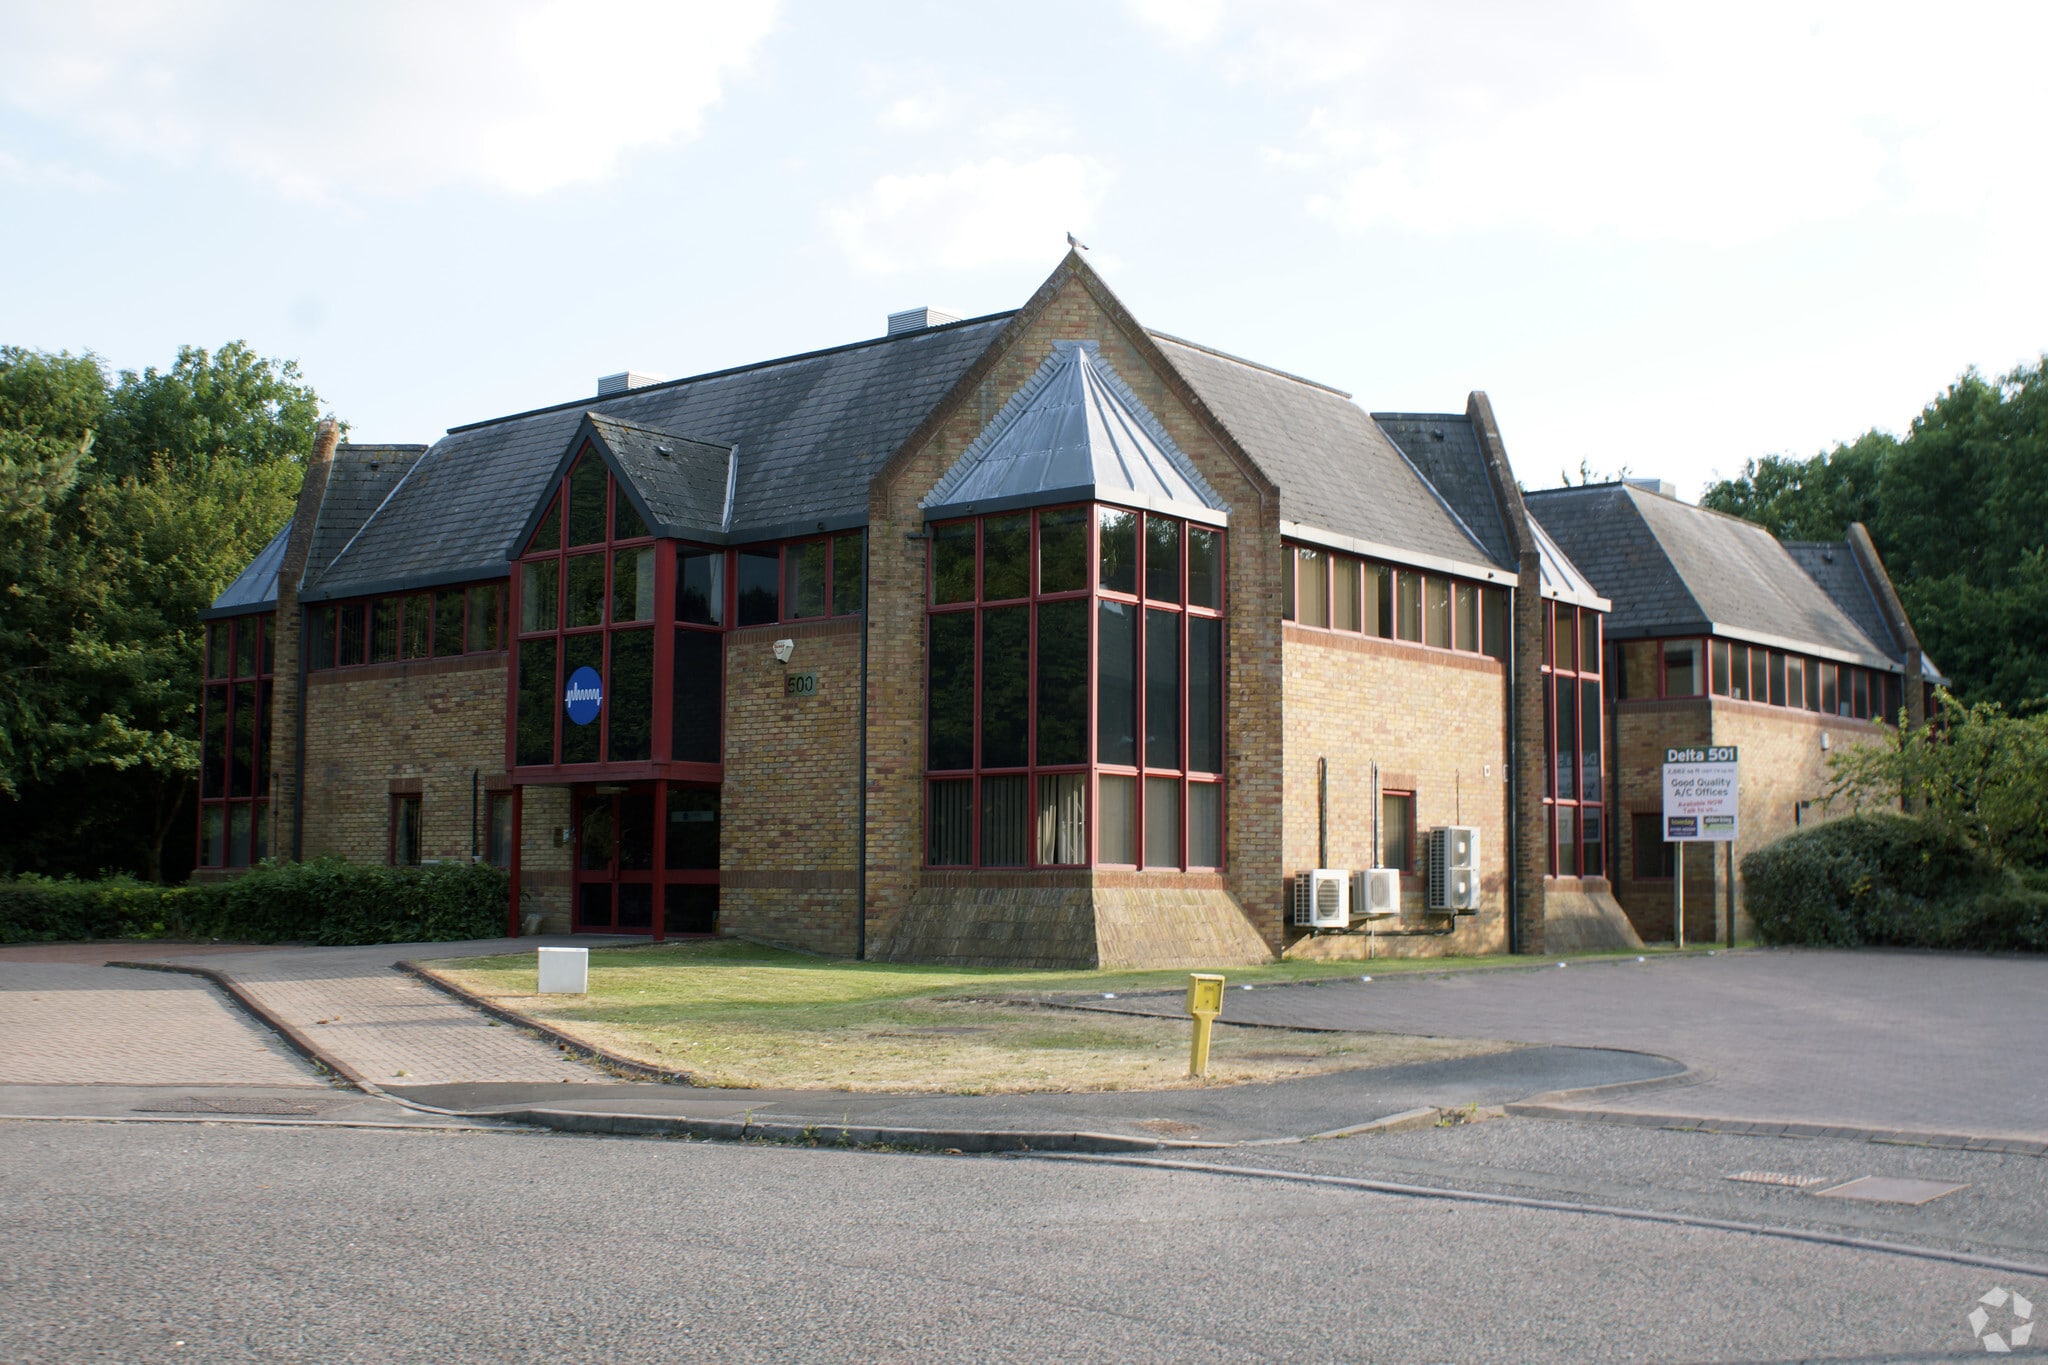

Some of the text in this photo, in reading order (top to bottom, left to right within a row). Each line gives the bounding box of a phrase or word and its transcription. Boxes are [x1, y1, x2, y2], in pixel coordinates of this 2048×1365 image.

[788, 676, 812, 693] 500
[1667, 748, 1734, 762] Delta 501
[1671, 778, 1731, 787] Good Quality
[1674, 788, 1728, 797] A/C Offices
